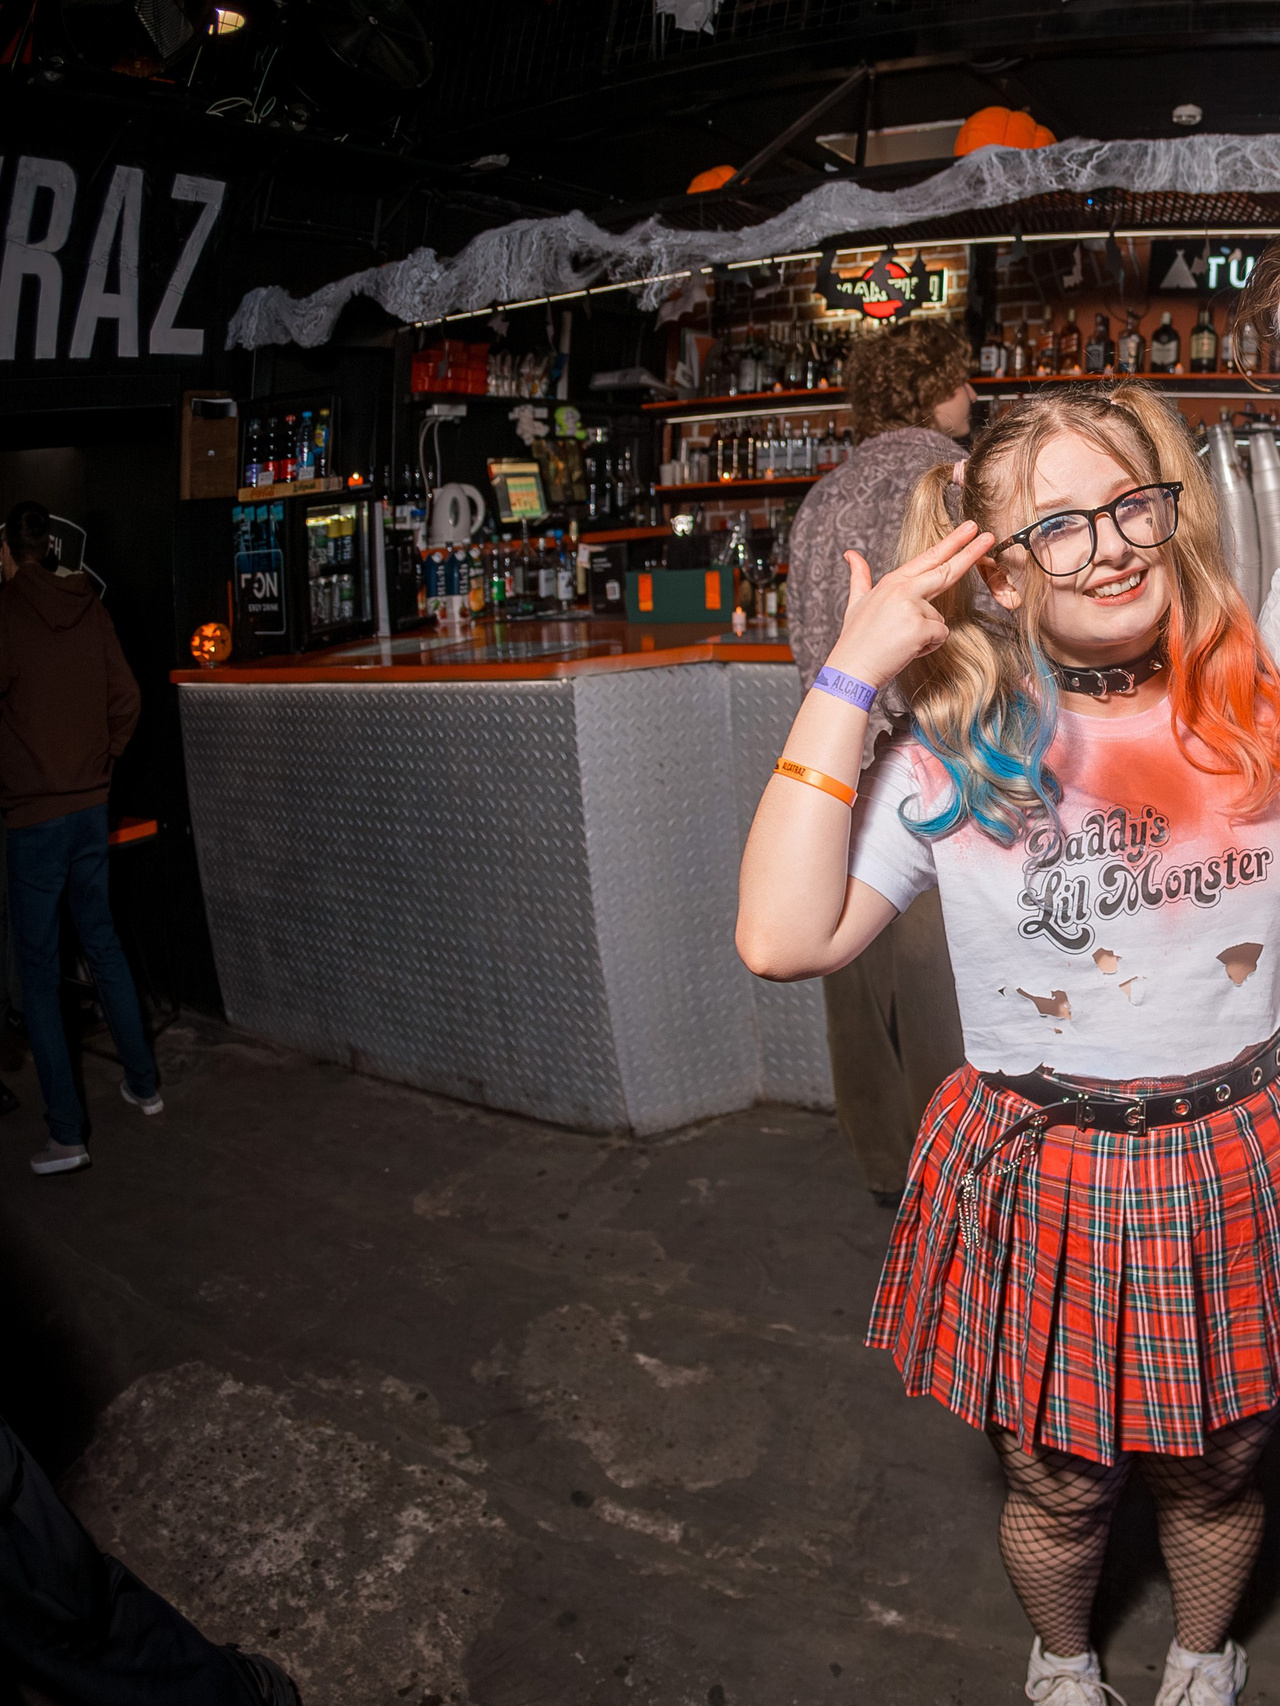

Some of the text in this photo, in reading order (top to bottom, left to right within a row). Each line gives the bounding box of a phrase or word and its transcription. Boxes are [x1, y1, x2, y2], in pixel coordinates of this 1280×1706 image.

[1022, 804, 1171, 874] Daddy's
[1017, 847, 1274, 954] Lil Monster
